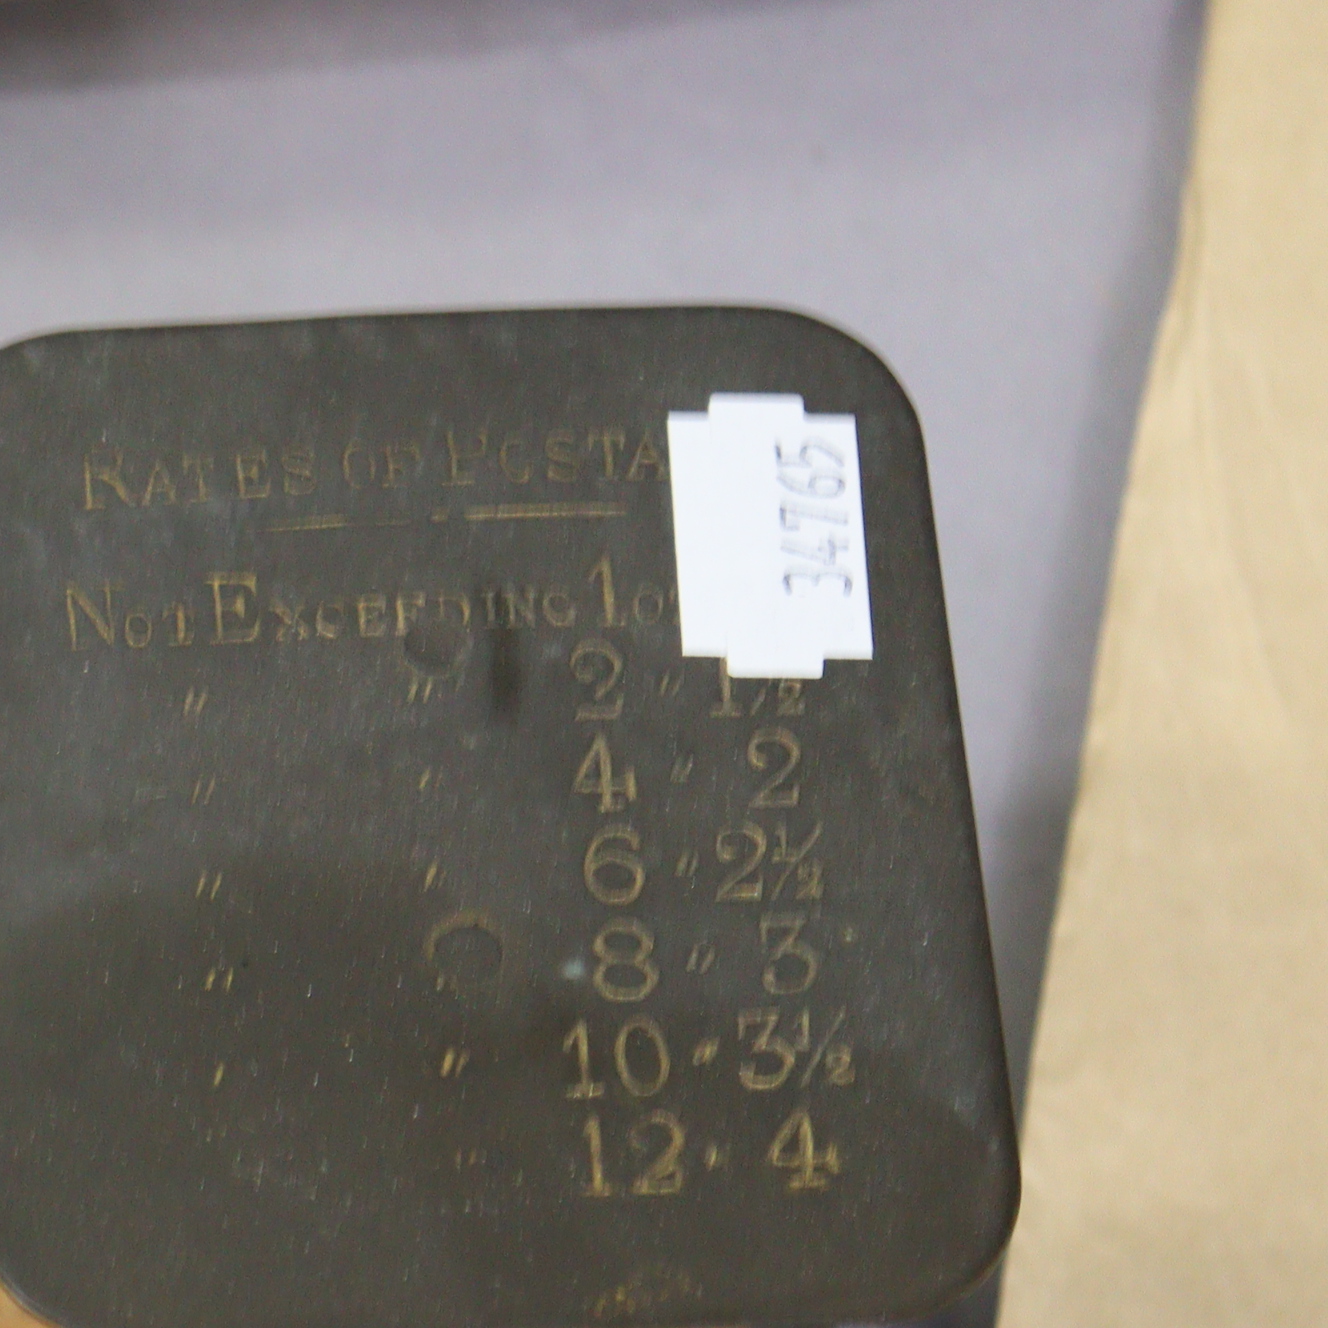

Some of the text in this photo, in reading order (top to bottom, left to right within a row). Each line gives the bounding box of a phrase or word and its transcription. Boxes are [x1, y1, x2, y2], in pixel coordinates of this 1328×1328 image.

[83, 441, 317, 510] RATES
[442, 427, 667, 487] POSTA
[775, 436, 852, 597] 34765
[570, 638, 623, 721] 2
[574, 729, 637, 814] 4
[747, 725, 801, 808] 2
[583, 822, 647, 906] 6
[592, 915, 660, 1001] 8
[759, 911, 818, 995] 3
[562, 1013, 670, 1098] 10
[581, 1108, 686, 1197] 12
[768, 1107, 841, 1194] 4
